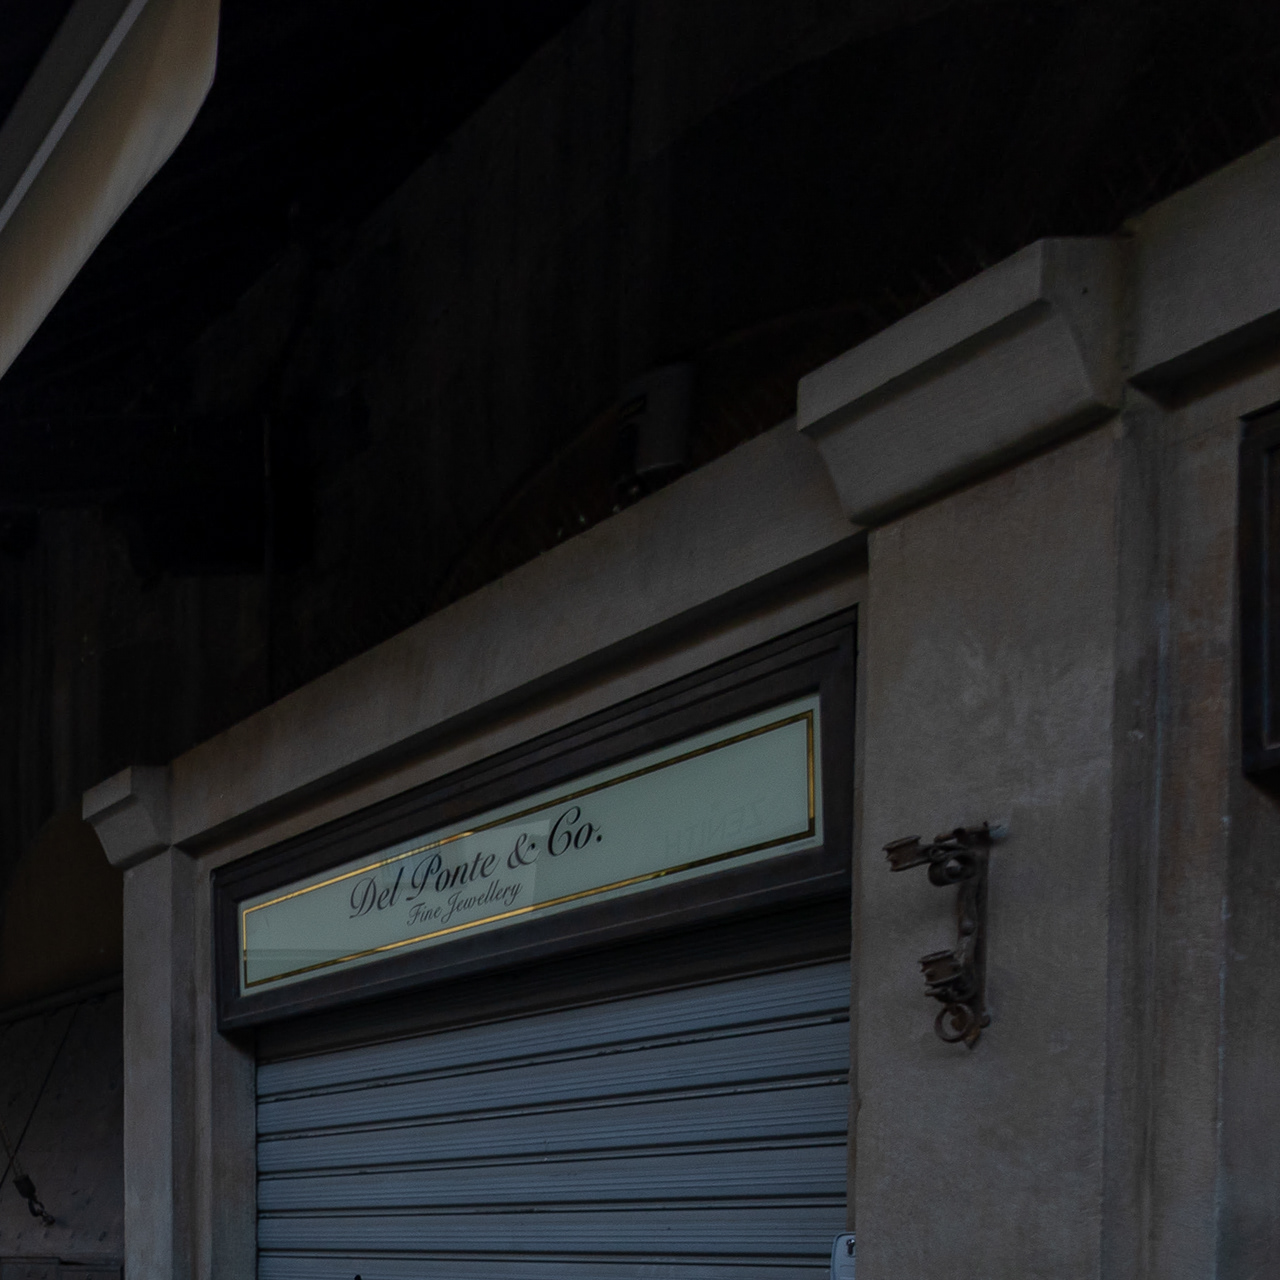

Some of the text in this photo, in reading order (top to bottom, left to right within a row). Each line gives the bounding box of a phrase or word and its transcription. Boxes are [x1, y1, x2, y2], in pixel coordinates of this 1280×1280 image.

[348, 805, 604, 919] Del Ponte & Co.
[406, 877, 523, 926] Fine Jewellery
